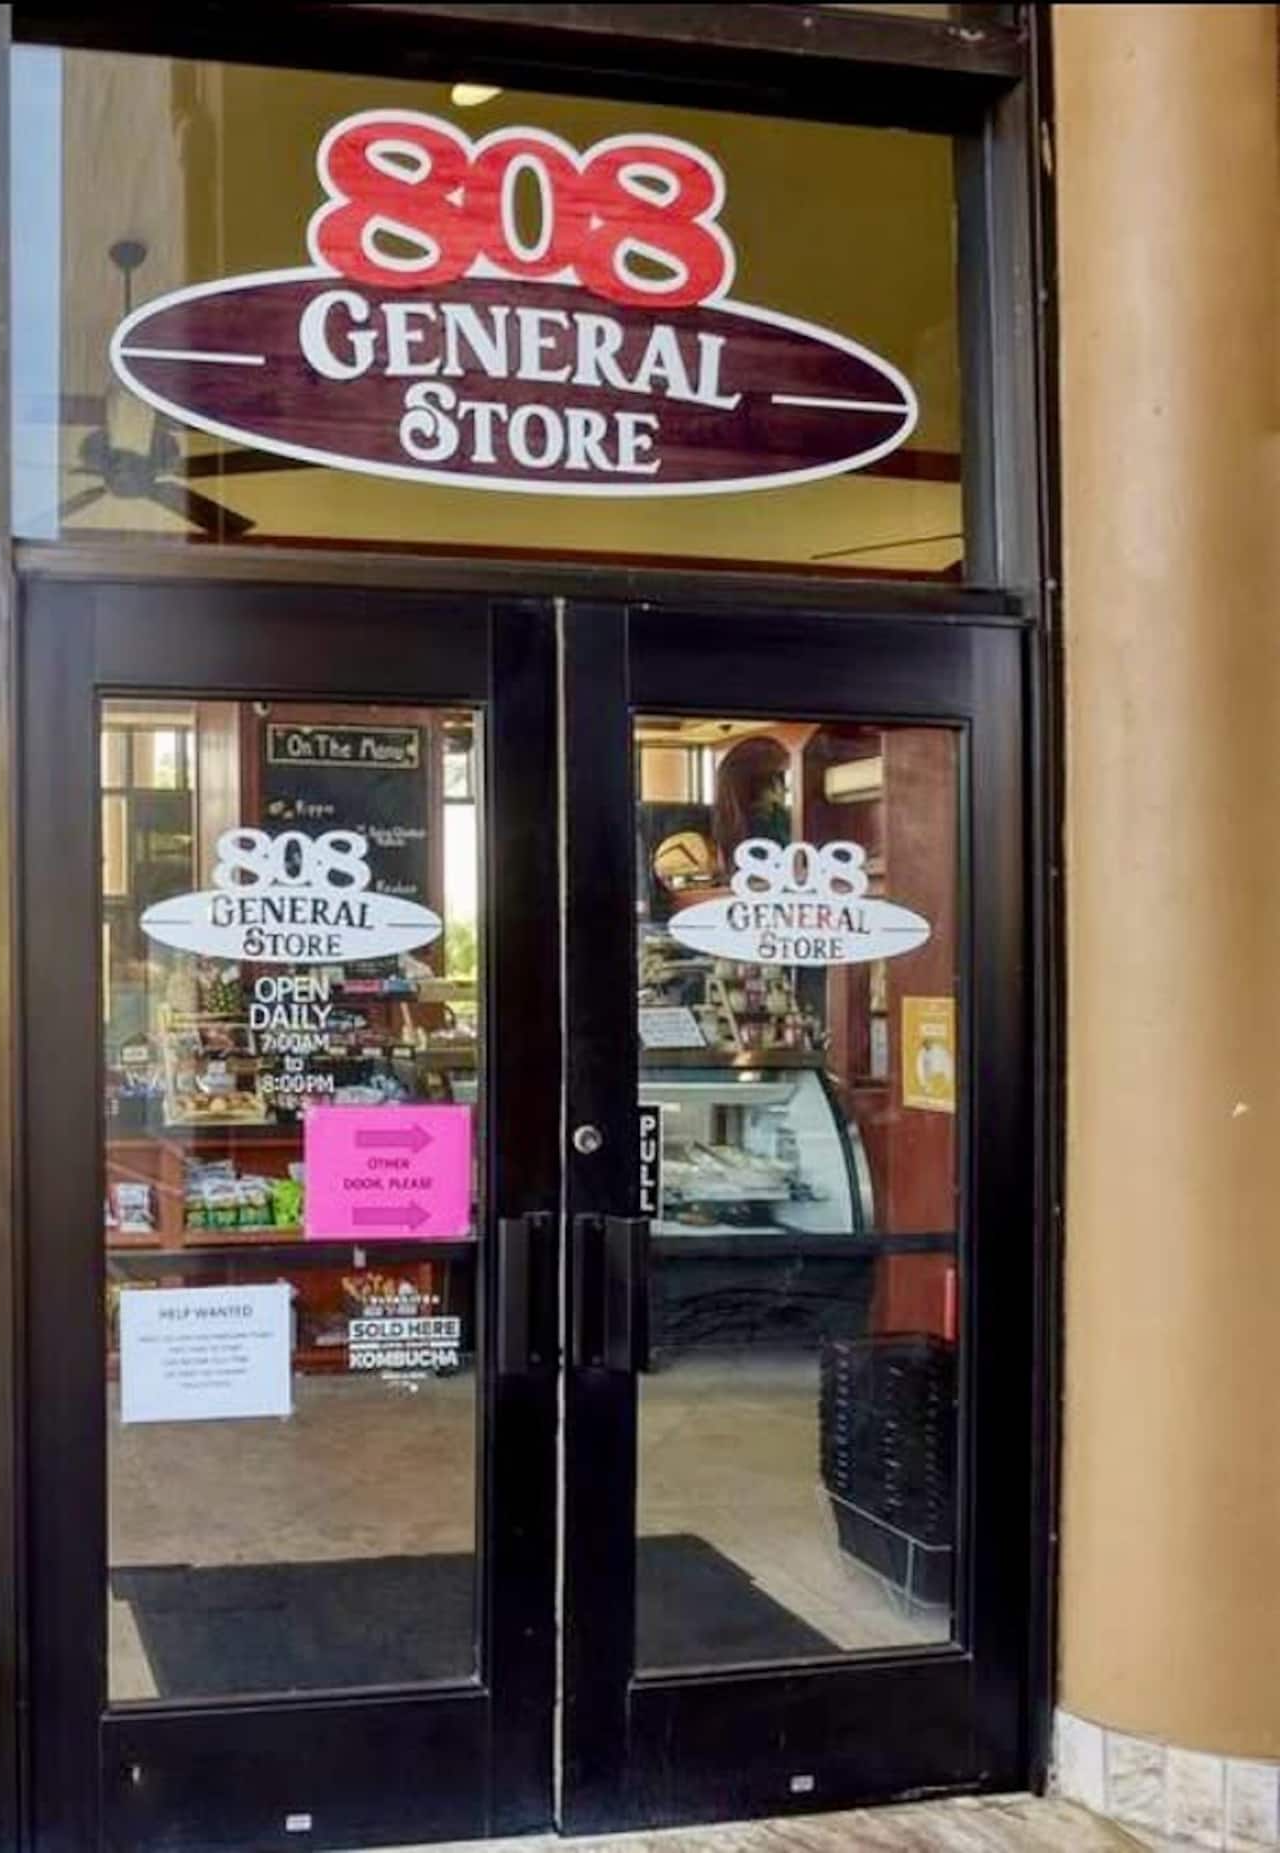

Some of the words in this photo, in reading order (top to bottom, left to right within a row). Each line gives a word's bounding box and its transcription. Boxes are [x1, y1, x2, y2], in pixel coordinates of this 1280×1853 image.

[307, 109, 736, 309] 808
[299, 290, 741, 412] GENERAL
[399, 382, 661, 475] STORE
[212, 827, 371, 893] 808
[730, 837, 869, 899] 808
[211, 894, 374, 931] GENERAL
[726, 901, 871, 935] GENERAL
[242, 926, 343, 957] STORE
[758, 930, 845, 959] STORE
[254, 972, 330, 1003] OPEN
[249, 1003, 333, 1031] DAILY
[284, 1055, 304, 1071] to
[261, 1074, 335, 1093] 8:00PM
[367, 1157, 410, 1170] OTHER
[639, 1115, 657, 1212] PULL
[388, 1177, 433, 1190] PLEASE
[159, 1307, 190, 1320] HELP
[194, 1303, 254, 1319] WANTED
[353, 1322, 403, 1338] SOLD
[408, 1320, 457, 1336] HERE
[348, 1349, 459, 1370] KOMBUCHA
